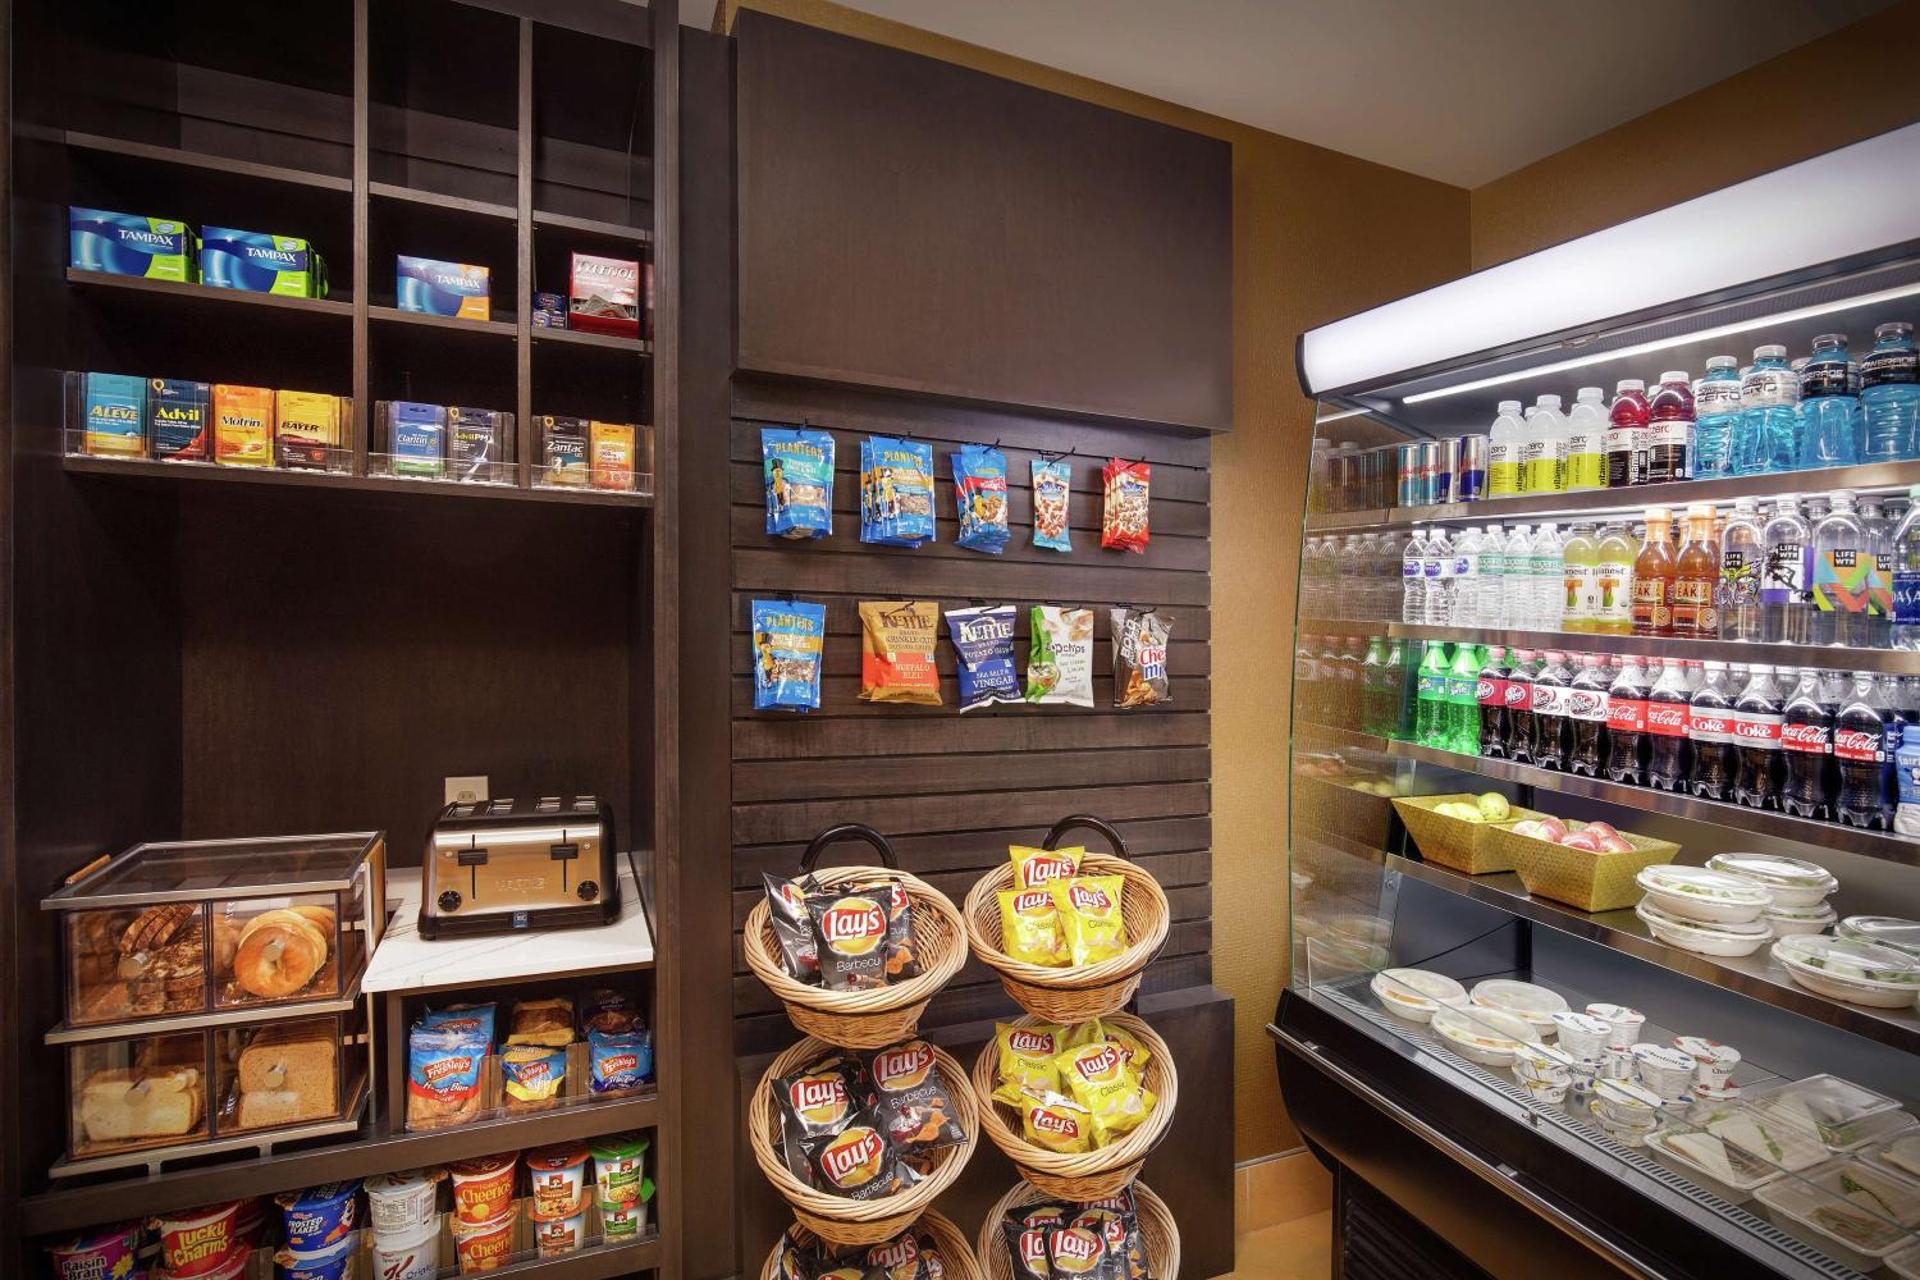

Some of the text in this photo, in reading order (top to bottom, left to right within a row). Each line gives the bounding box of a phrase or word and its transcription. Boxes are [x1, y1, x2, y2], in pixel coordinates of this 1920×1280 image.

[118, 229, 174, 246] TAMPAX
[247, 247, 296, 263] TAMPAX
[437, 274, 480, 289] TAMPAX
[1742, 382, 1777, 395] ERO
[89, 403, 139, 420] ALEVE
[155, 406, 200, 421] Advil
[220, 415, 261, 428] Motrin
[281, 420, 320, 433] BAYER
[546, 440, 585, 453] Zantac
[1779, 544, 1798, 552] LIFE
[1779, 551, 1798, 559] WTR
[1835, 551, 1856, 559] LIFE
[1835, 558, 1856, 566] WTR
[1878, 555, 1891, 563] LIF
[1878, 562, 1891, 570] WT
[1677, 587, 1697, 597] EAK
[958, 618, 1014, 643] KETTLE
[1138, 648, 1164, 666] Che
[972, 675, 1014, 688] VINEGAR
[1691, 717, 1726, 732] Coke
[1736, 722, 1772, 737] Coke
[1834, 728, 1882, 751] oca-Cola
[1028, 857, 1072, 887] Lay's
[829, 907, 881, 941] Lay's
[836, 957, 881, 973] Barbecu
[1011, 1032, 1052, 1050] Lay's
[880, 1045, 928, 1081] Lay's
[1078, 1045, 1120, 1076] Lay's
[799, 1078, 845, 1112] Lay's
[890, 1085, 937, 1109] Barbecue
[1032, 1108, 1077, 1134] Lay's
[826, 1131, 876, 1181] Lay's
[850, 1171, 895, 1200] Barbecue
[178, 1219, 228, 1247] Lucky
[173, 1237, 229, 1268] Charms
[62, 1255, 107, 1273] Raisin
[67, 1268, 103, 1280] Bran
